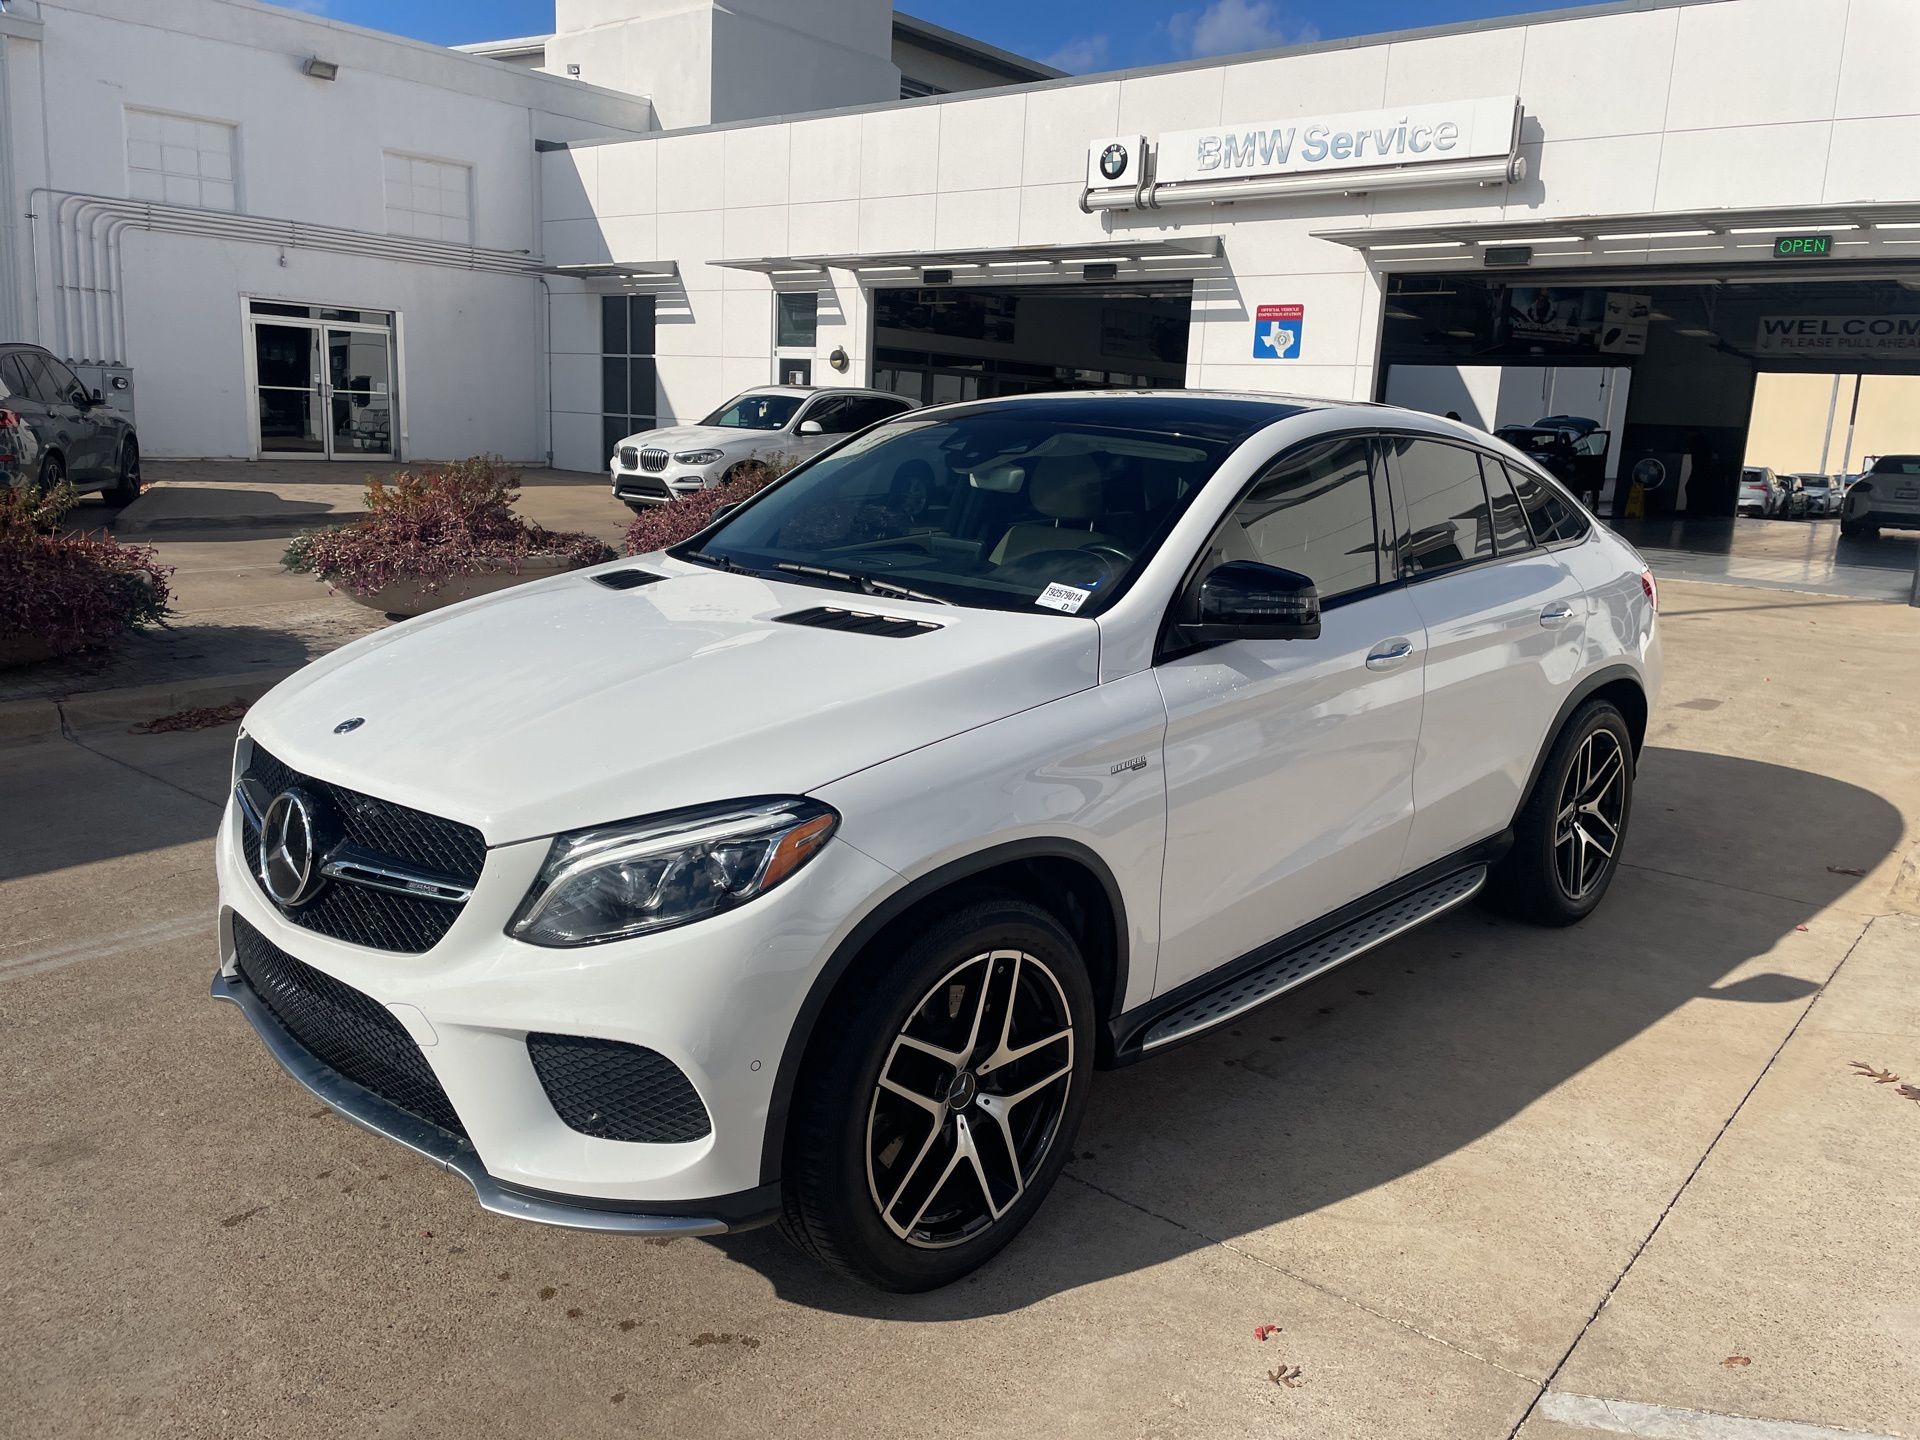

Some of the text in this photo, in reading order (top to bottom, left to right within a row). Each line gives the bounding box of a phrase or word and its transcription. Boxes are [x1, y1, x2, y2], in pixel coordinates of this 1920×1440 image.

[1197, 116, 1459, 171] BMW Service
[1779, 238, 1826, 253] OPEN
[1780, 337, 1920, 349] PLEASE PULL AHEA
